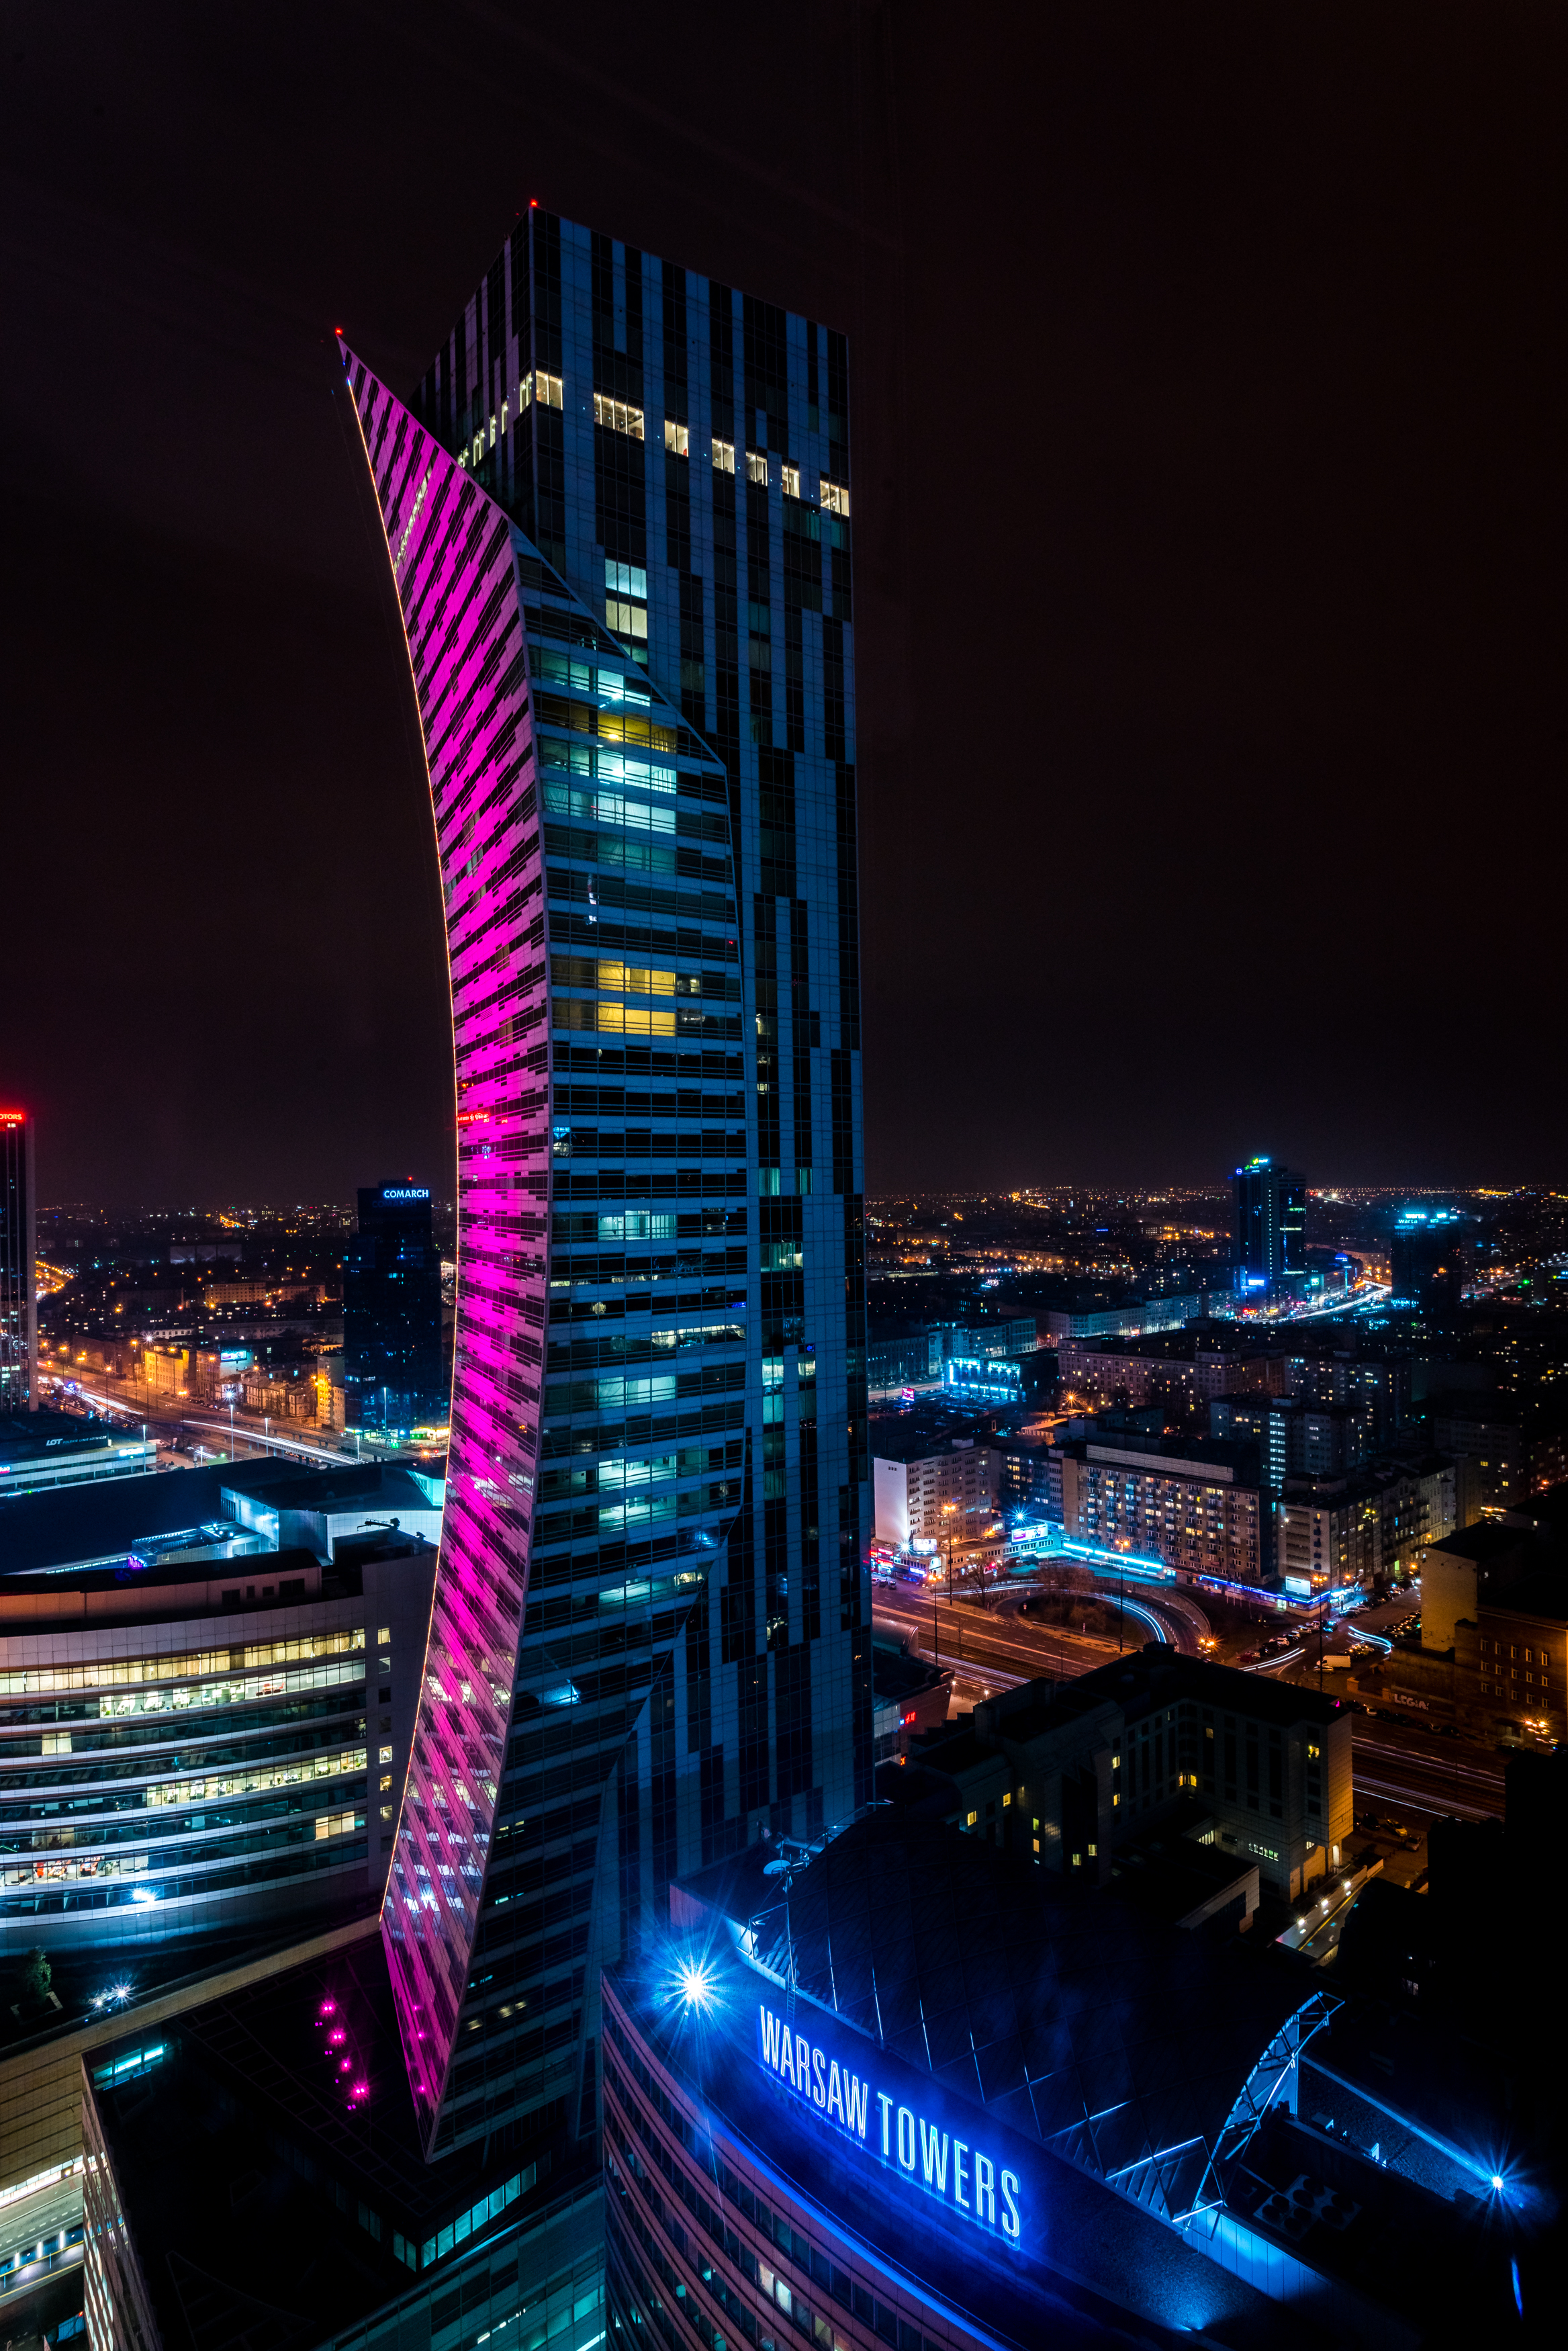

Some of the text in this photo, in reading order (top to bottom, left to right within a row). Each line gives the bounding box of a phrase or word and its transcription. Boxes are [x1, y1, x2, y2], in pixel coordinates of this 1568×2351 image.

[383, 1190, 428, 1198] COMARCH
[46, 1438, 63, 1446] LOT
[760, 2005, 1020, 2238] WARSAW TOWERS
